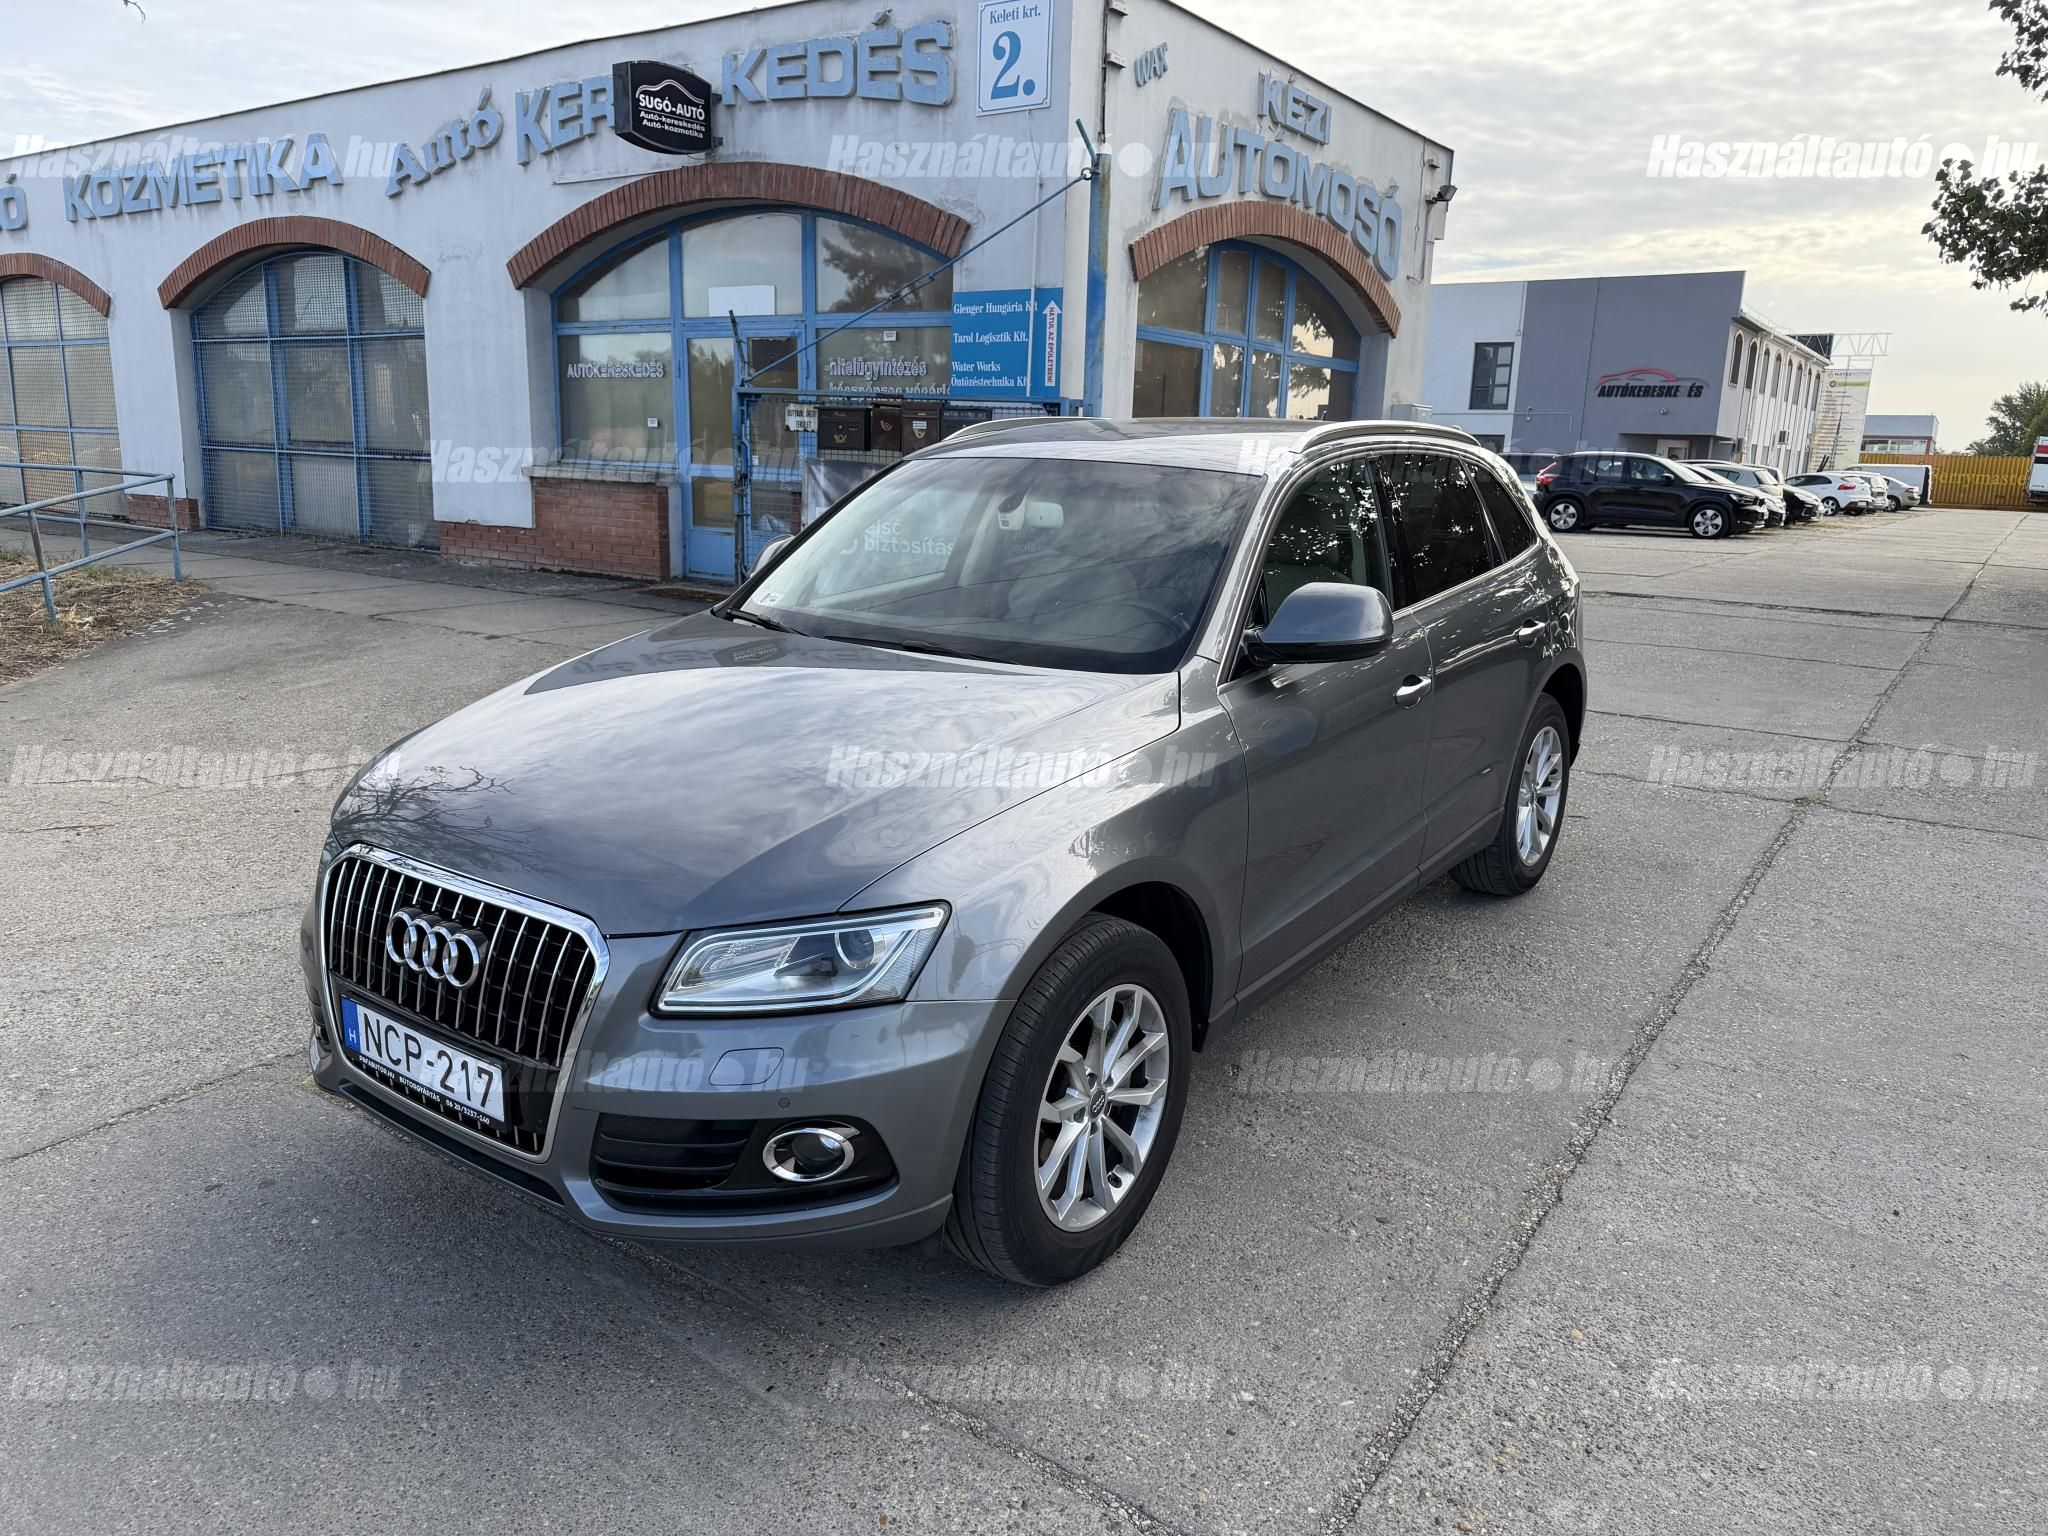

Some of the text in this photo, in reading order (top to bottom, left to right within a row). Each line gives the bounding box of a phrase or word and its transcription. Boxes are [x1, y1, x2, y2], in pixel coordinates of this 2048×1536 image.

[989, 4, 1042, 24] Keleti krt.
[990, 30, 1036, 100] 2.
[1133, 42, 1168, 88] WAX
[638, 94, 705, 121] SUGÓ-AUTÓ
[640, 111, 706, 132] Autó-kereskedés
[385, 84, 503, 198] Autó
[62, 132, 344, 222] KOZMETIKA
[953, 301, 1038, 316] Gienger Hungária Kt
[953, 331, 1029, 346] Tarol Logisztik Kft.
[952, 361, 1001, 372] Water Works
[951, 374, 1032, 387] Öntözéstechnika Kf.
[1597, 382, 1704, 398] AUTÓKERESKEÉS
[1932, 467, 2027, 488] Ferrymaste
[348, 1028, 357, 1044] H
[363, 1012, 494, 1108] NCP-217
